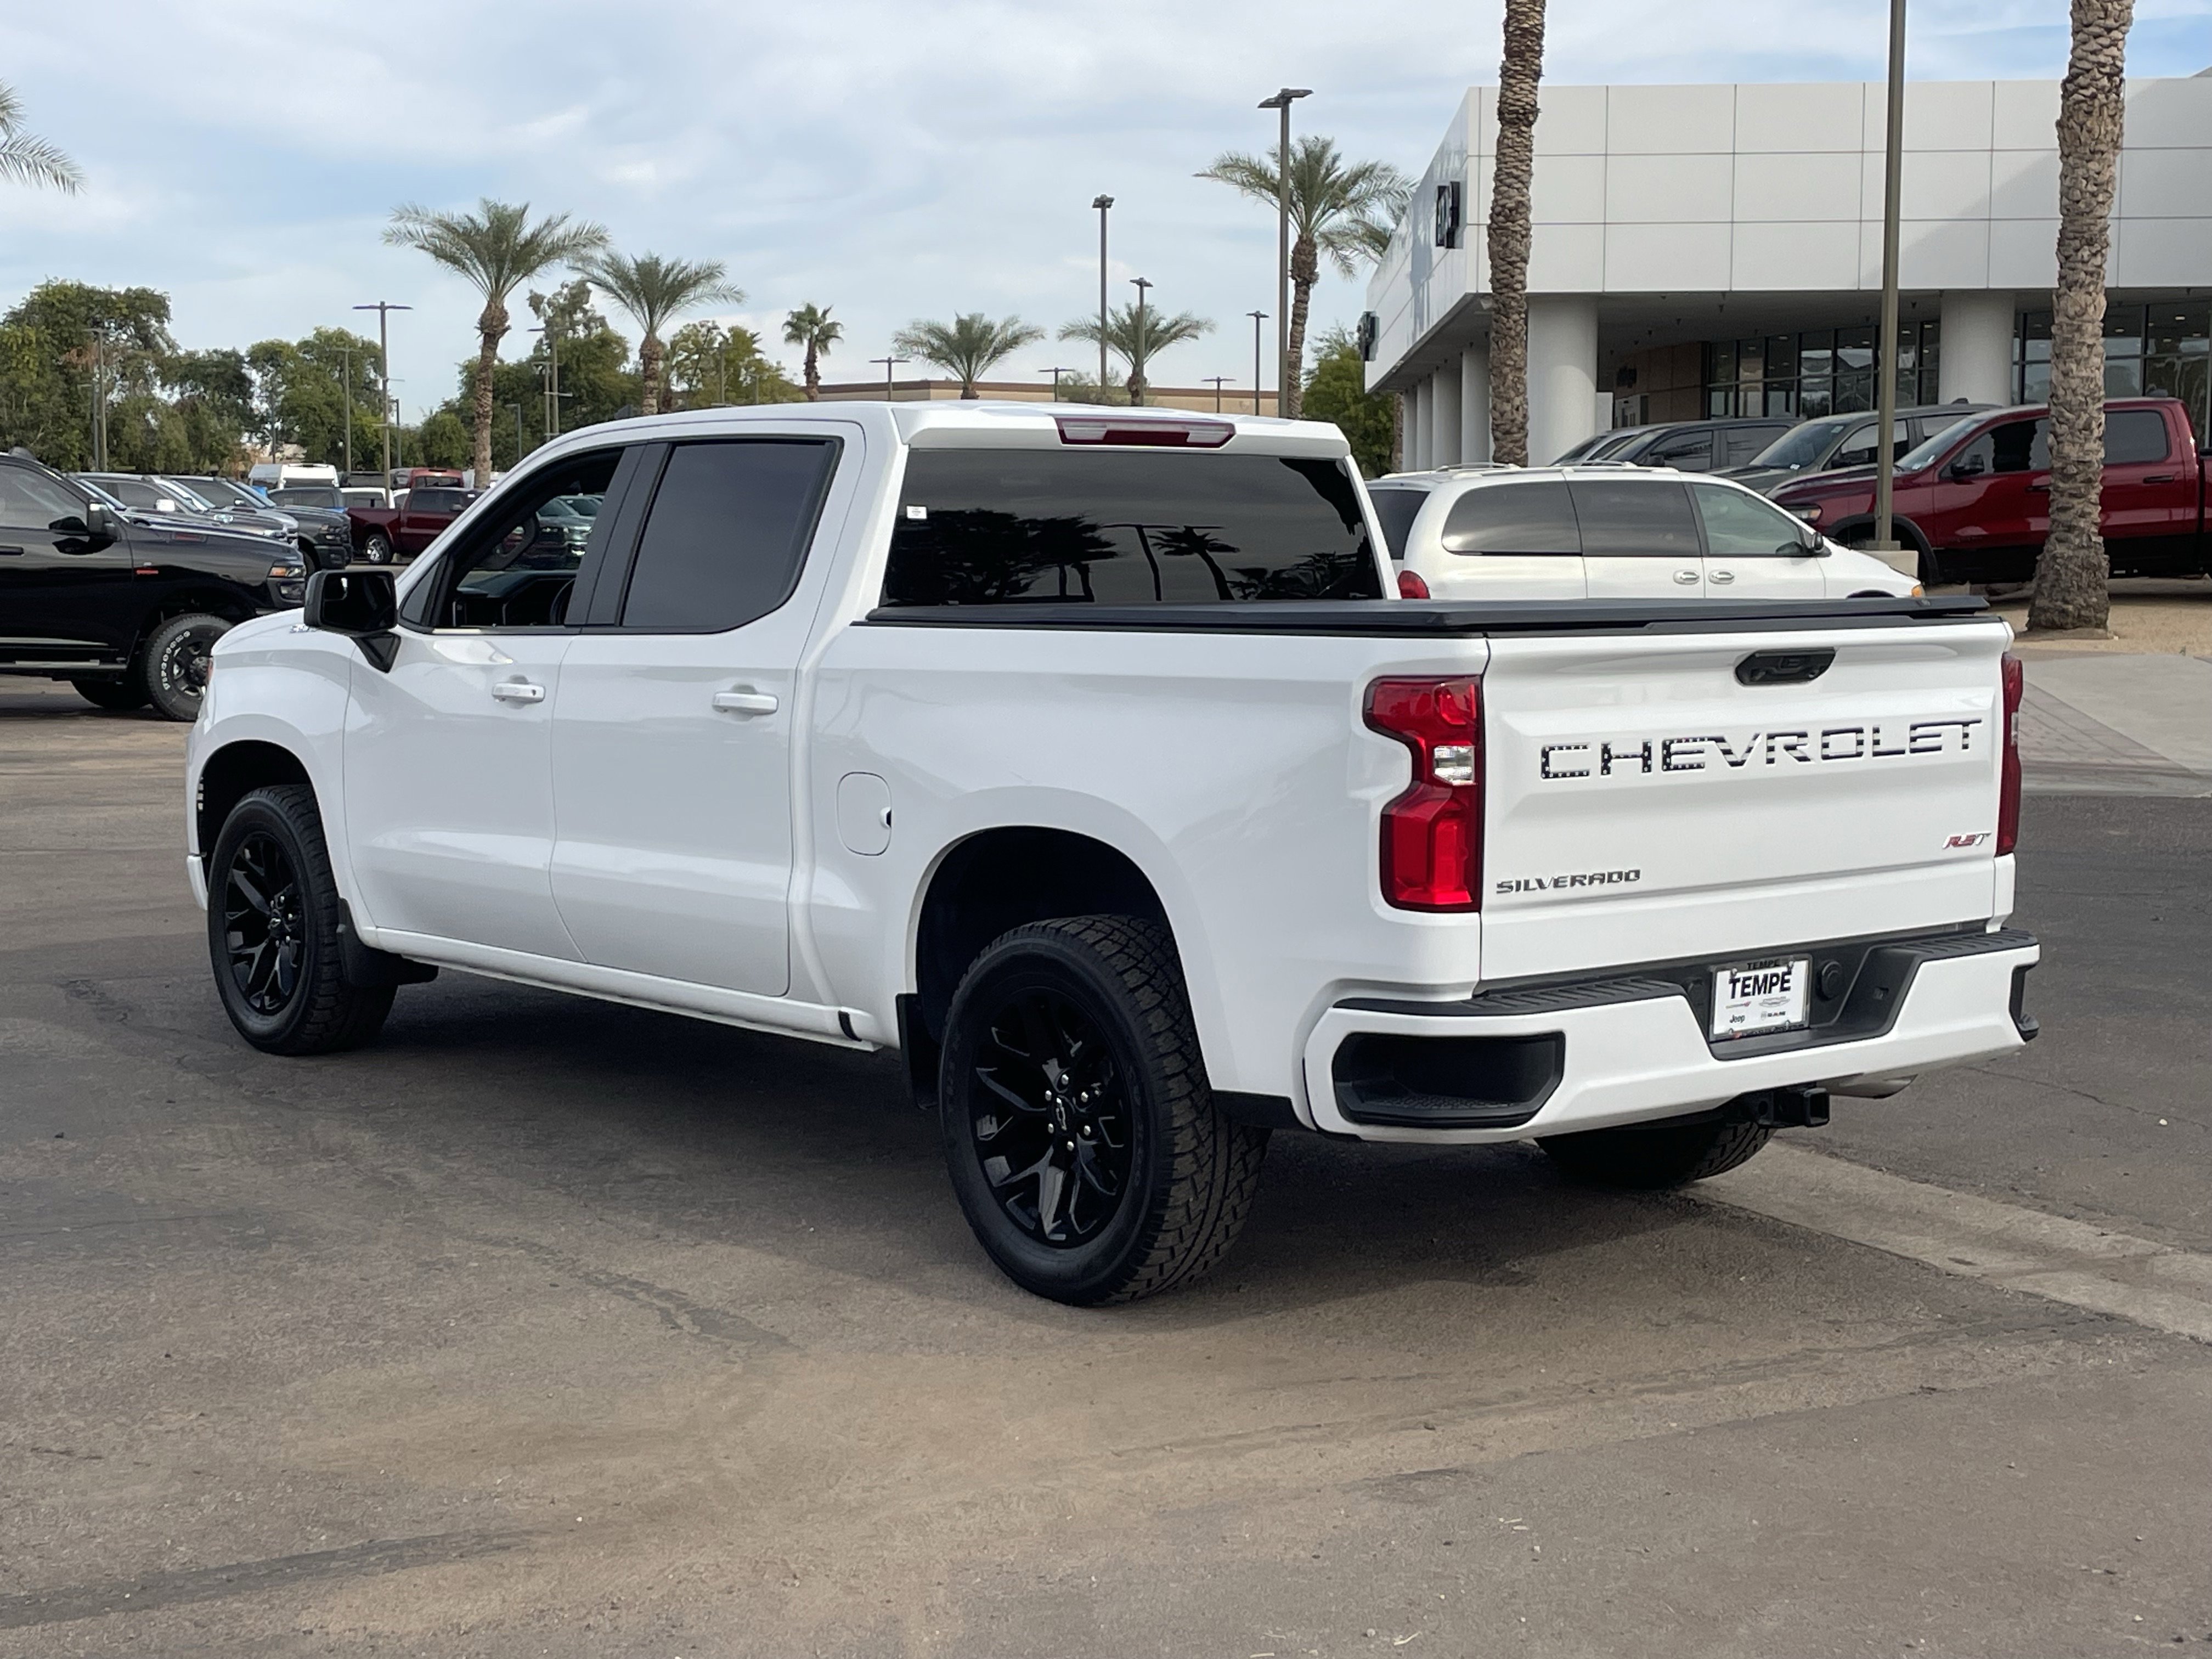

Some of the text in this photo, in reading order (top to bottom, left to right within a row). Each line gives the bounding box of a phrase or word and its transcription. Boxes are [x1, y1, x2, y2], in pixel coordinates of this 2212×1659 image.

[1541, 718, 1983, 779] CHEVROLET
[1496, 870, 1640, 894] SILVERADO
[1747, 959, 1780, 970] TEMPE
[1729, 970, 1791, 998] TEMPE
[1729, 1014, 1745, 1023] Jeep
